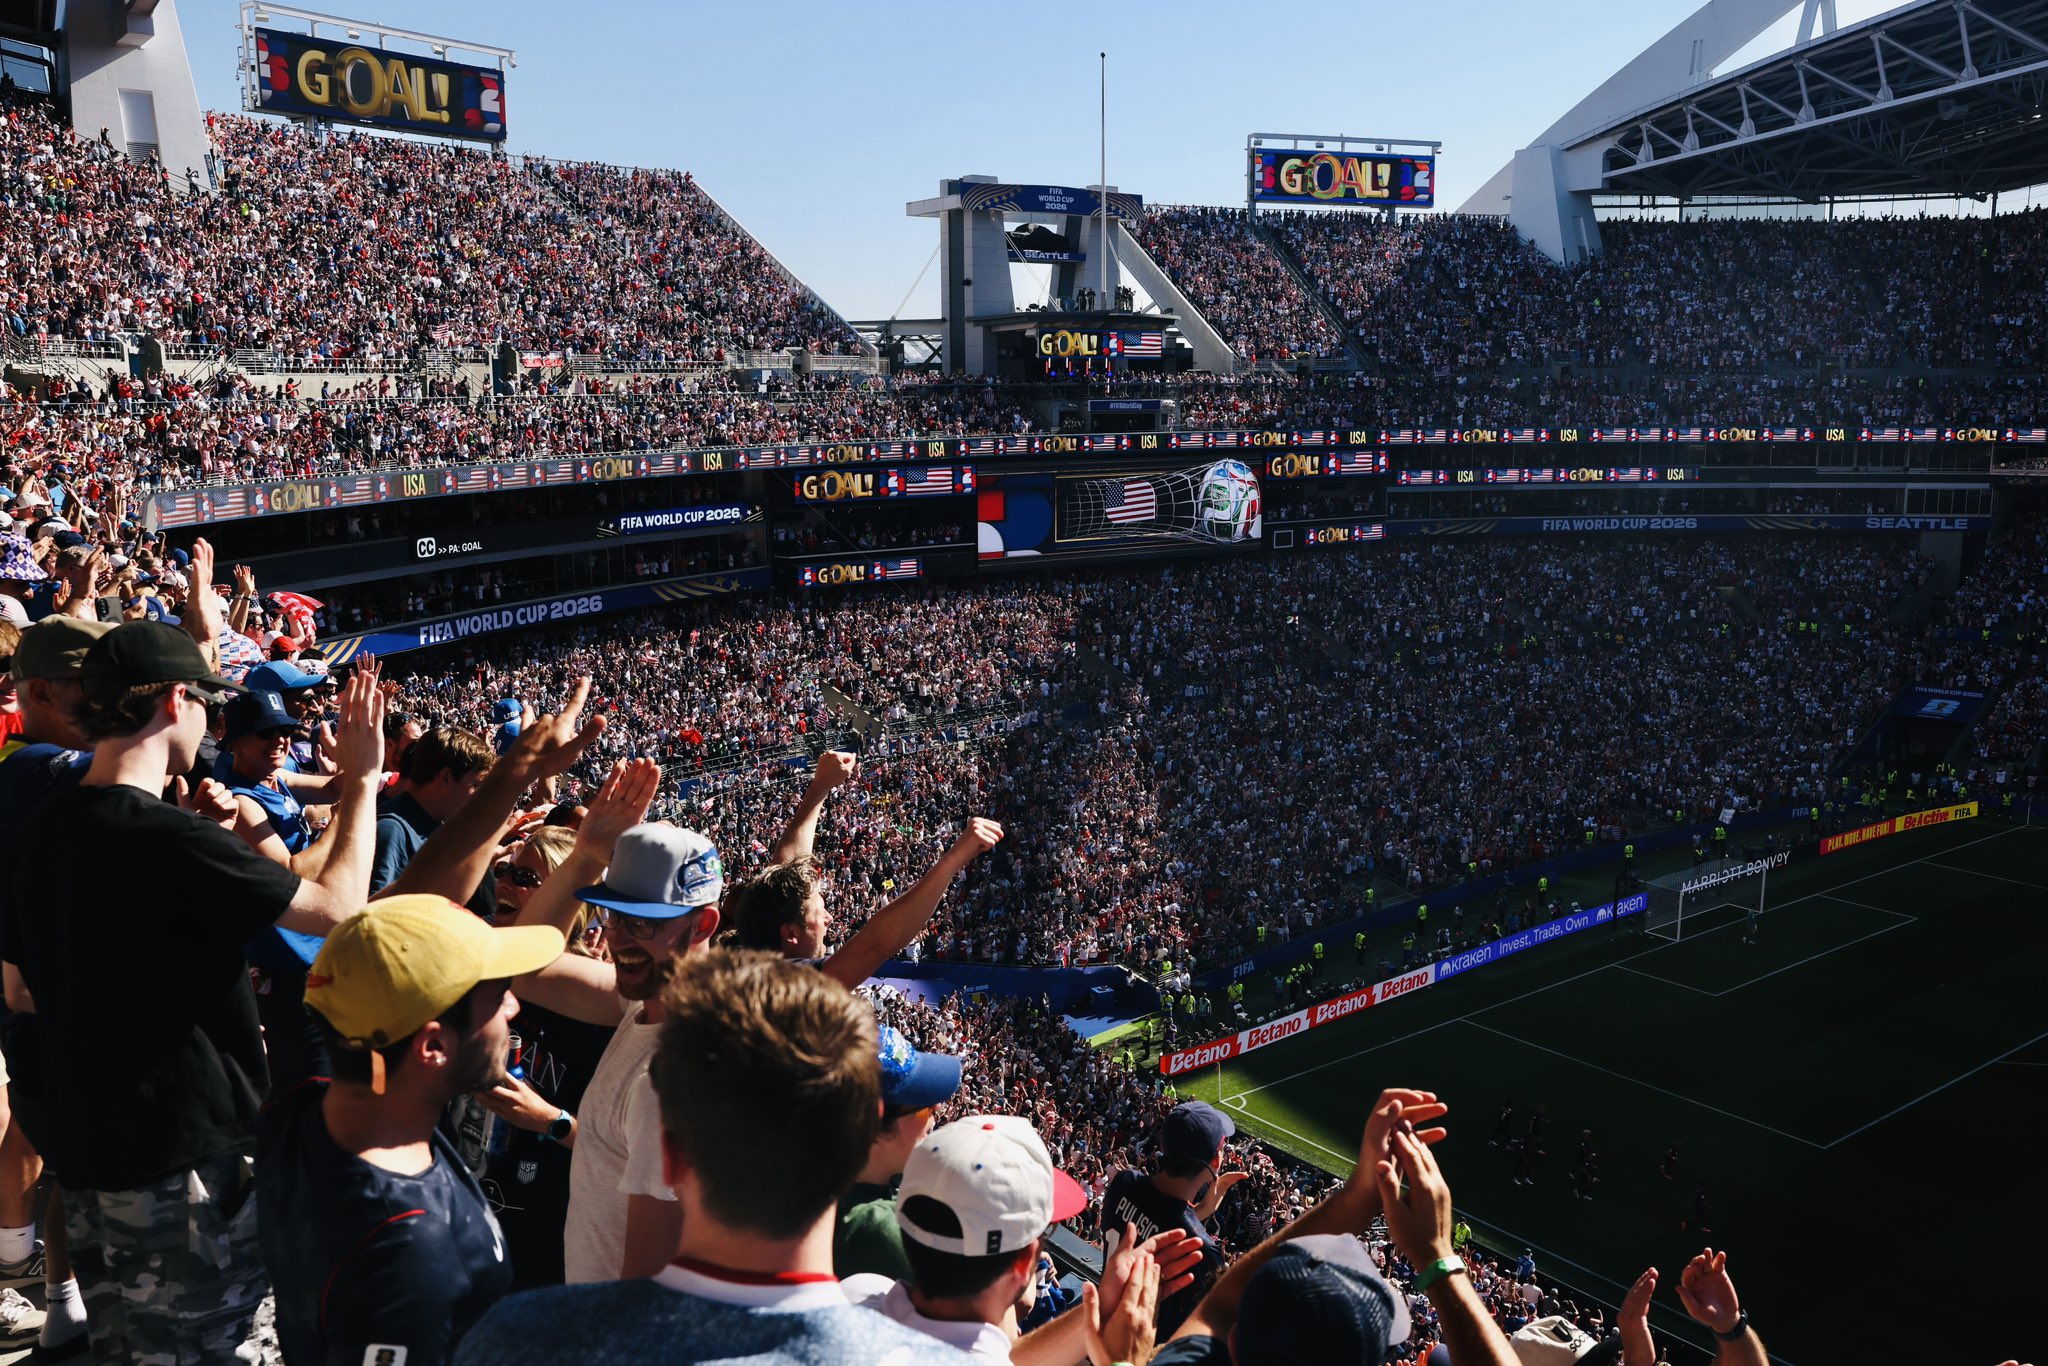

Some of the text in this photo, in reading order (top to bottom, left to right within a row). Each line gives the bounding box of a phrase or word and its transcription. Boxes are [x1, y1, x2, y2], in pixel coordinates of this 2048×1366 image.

[297, 46, 450, 124] GOAL!
[1280, 153, 1391, 199] GOAL!
[1038, 195, 1075, 204] WORLD CUP
[1024, 251, 1069, 260] SEATTLE
[1040, 329, 1098, 357] GOAL!
[1141, 434, 1157, 449] USA
[1253, 431, 1287, 447] GOAL!
[1350, 430, 1366, 445] USA
[1463, 429, 1497, 443] GOAL!
[1560, 428, 1578, 442] USA
[1719, 427, 1757, 442] GOAL!
[1825, 428, 1845, 441] USA
[1956, 427, 1998, 442] GOAL!
[928, 441, 945, 458] USA
[1044, 436, 1077, 452] GOAL!
[703, 452, 723, 471] USA
[826, 445, 864, 465] GOAL!
[592, 457, 633, 480] GOAL!
[1271, 452, 1320, 477] GOAL!
[1457, 470, 1474, 483] USA
[1569, 468, 1603, 482] GOAL!
[1667, 469, 1684, 481] USA
[403, 473, 426, 497] USA
[802, 470, 873, 500] GOAL!
[270, 483, 320, 513] GOAL!
[620, 507, 740, 531] FIFA WORLD CUP 2026
[1542, 517, 1698, 531] FIFA WORLD CUP 2026
[1865, 517, 1969, 530] SEATTLE
[1318, 527, 1348, 544] GOAL!
[417, 538, 435, 557] CC
[448, 544, 461, 553] PA:
[461, 541, 482, 552] GOAL
[818, 563, 865, 584] GOAL!
[419, 595, 602, 645] FIFA WORLD CUP 2026
[1928, 687, 1949, 695] WORLD
[1791, 806, 1809, 818] FIFA
[1954, 806, 1971, 819] FIFA
[1861, 825, 1876, 842] HAVE
[1876, 822, 1890, 836] FUN!
[1499, 933, 1532, 956] Invest,
[1533, 923, 1564, 945] Trade,
[1565, 916, 1589, 932] Own
[1233, 959, 1255, 979] FIFA
[1169, 970, 1429, 1075] Betano Betano Betano Betano
[519, 1162, 538, 1173] USA
